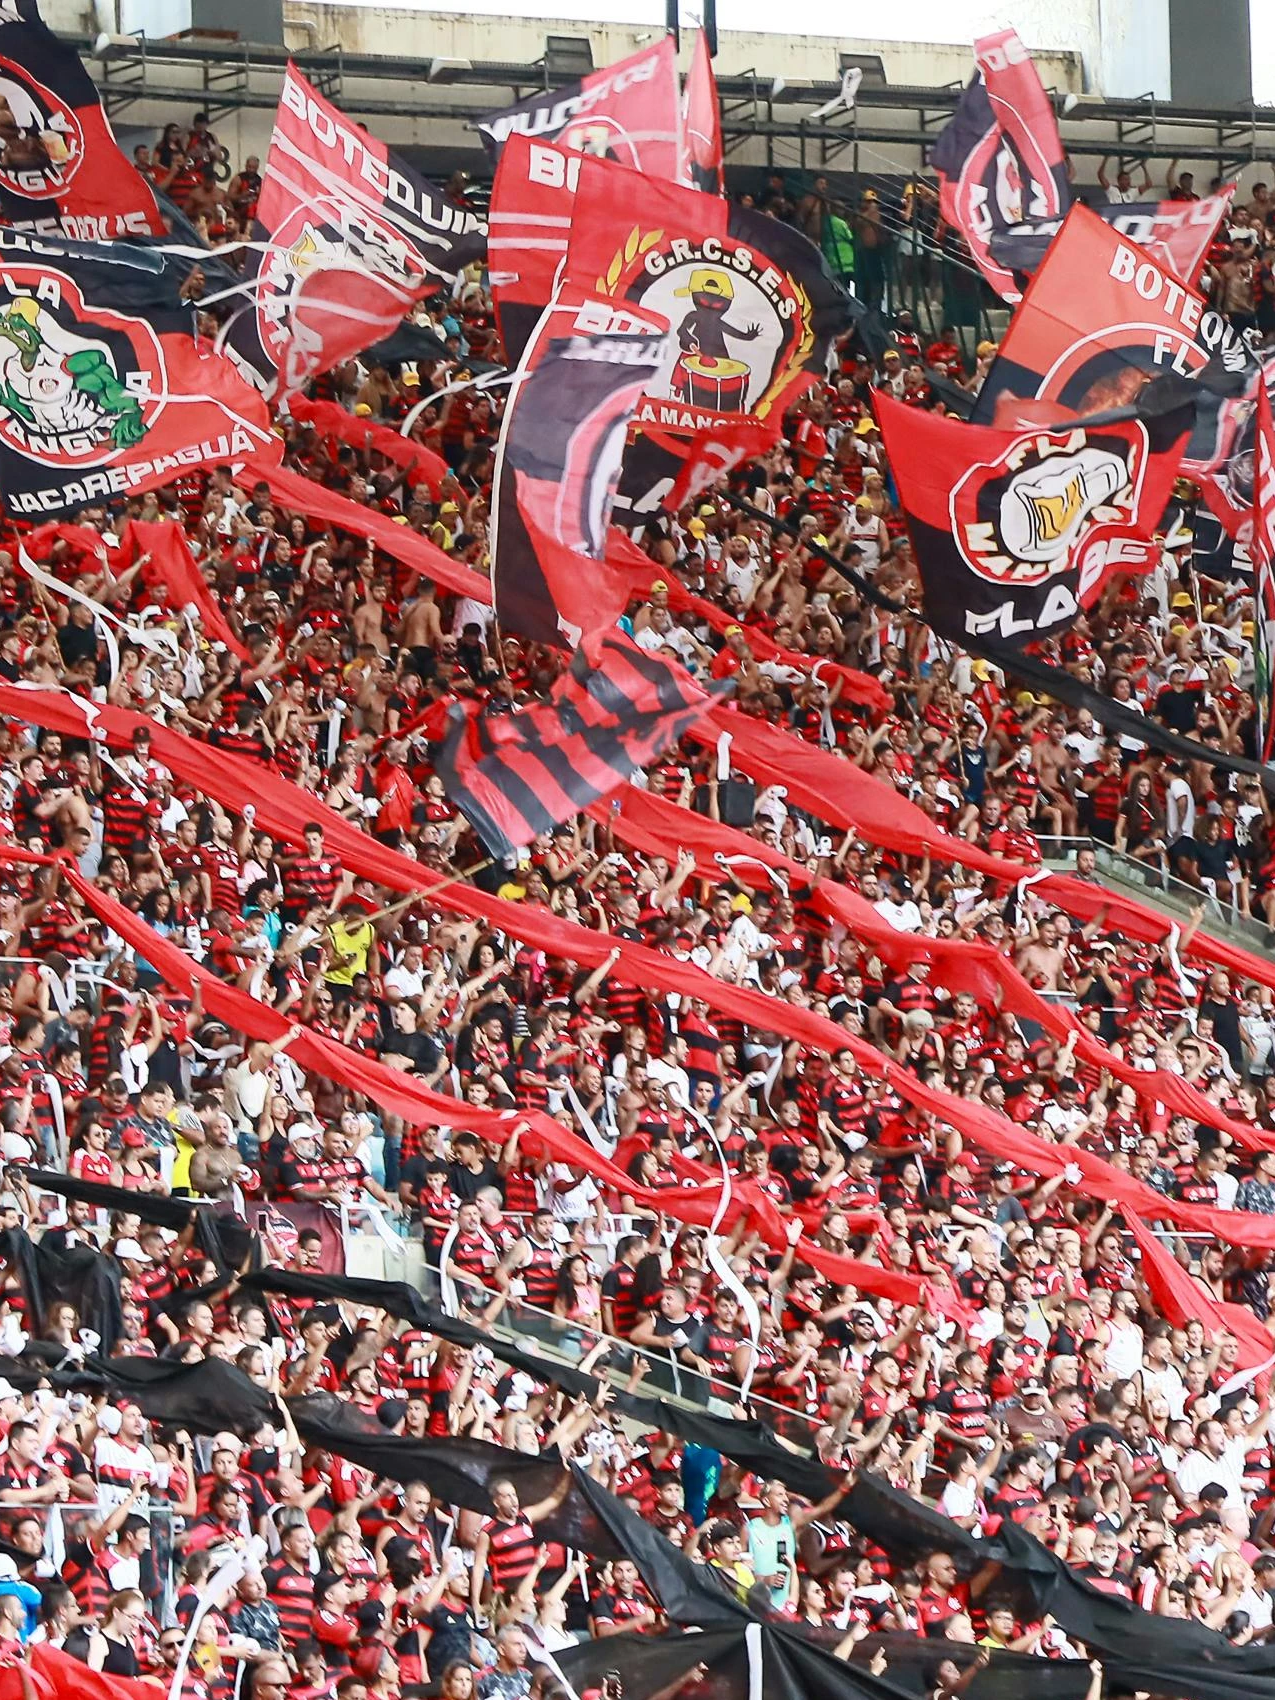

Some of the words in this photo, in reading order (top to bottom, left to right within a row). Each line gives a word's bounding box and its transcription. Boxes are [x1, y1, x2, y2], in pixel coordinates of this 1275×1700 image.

[281, 72, 489, 237] BOTEQUIM
[9, 423, 256, 514] JACAREPAGUÁ
[1004, 427, 1087, 472] FLA
[965, 585, 1079, 638] FLA
